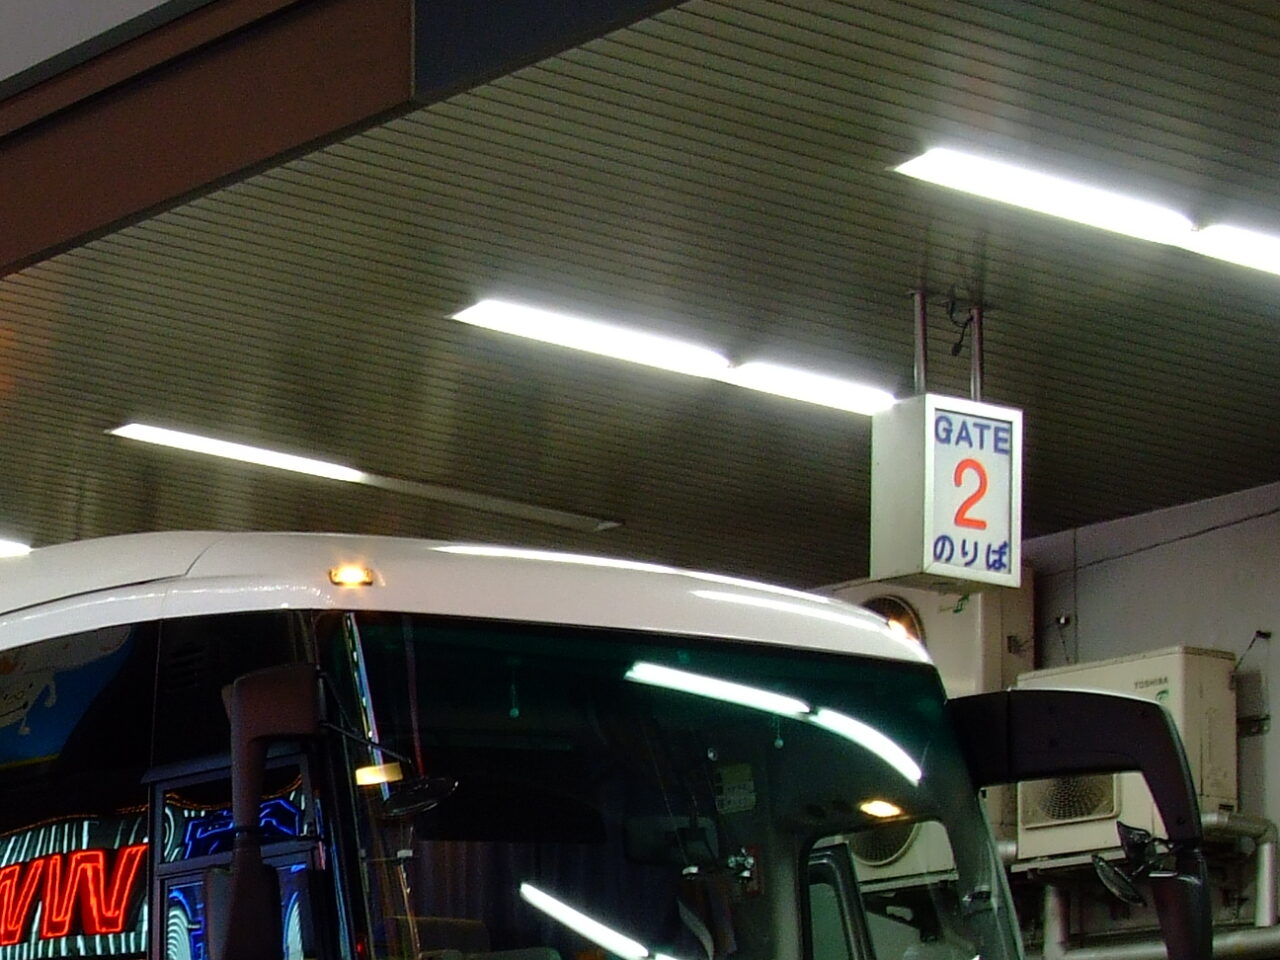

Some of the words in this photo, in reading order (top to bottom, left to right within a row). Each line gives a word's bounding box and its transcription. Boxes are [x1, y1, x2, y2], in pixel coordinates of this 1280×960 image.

[934, 415, 1011, 456] GATE
[953, 458, 990, 531] 2
[933, 534, 1009, 571] のりば
[1133, 676, 1169, 691] TOSHIBA
